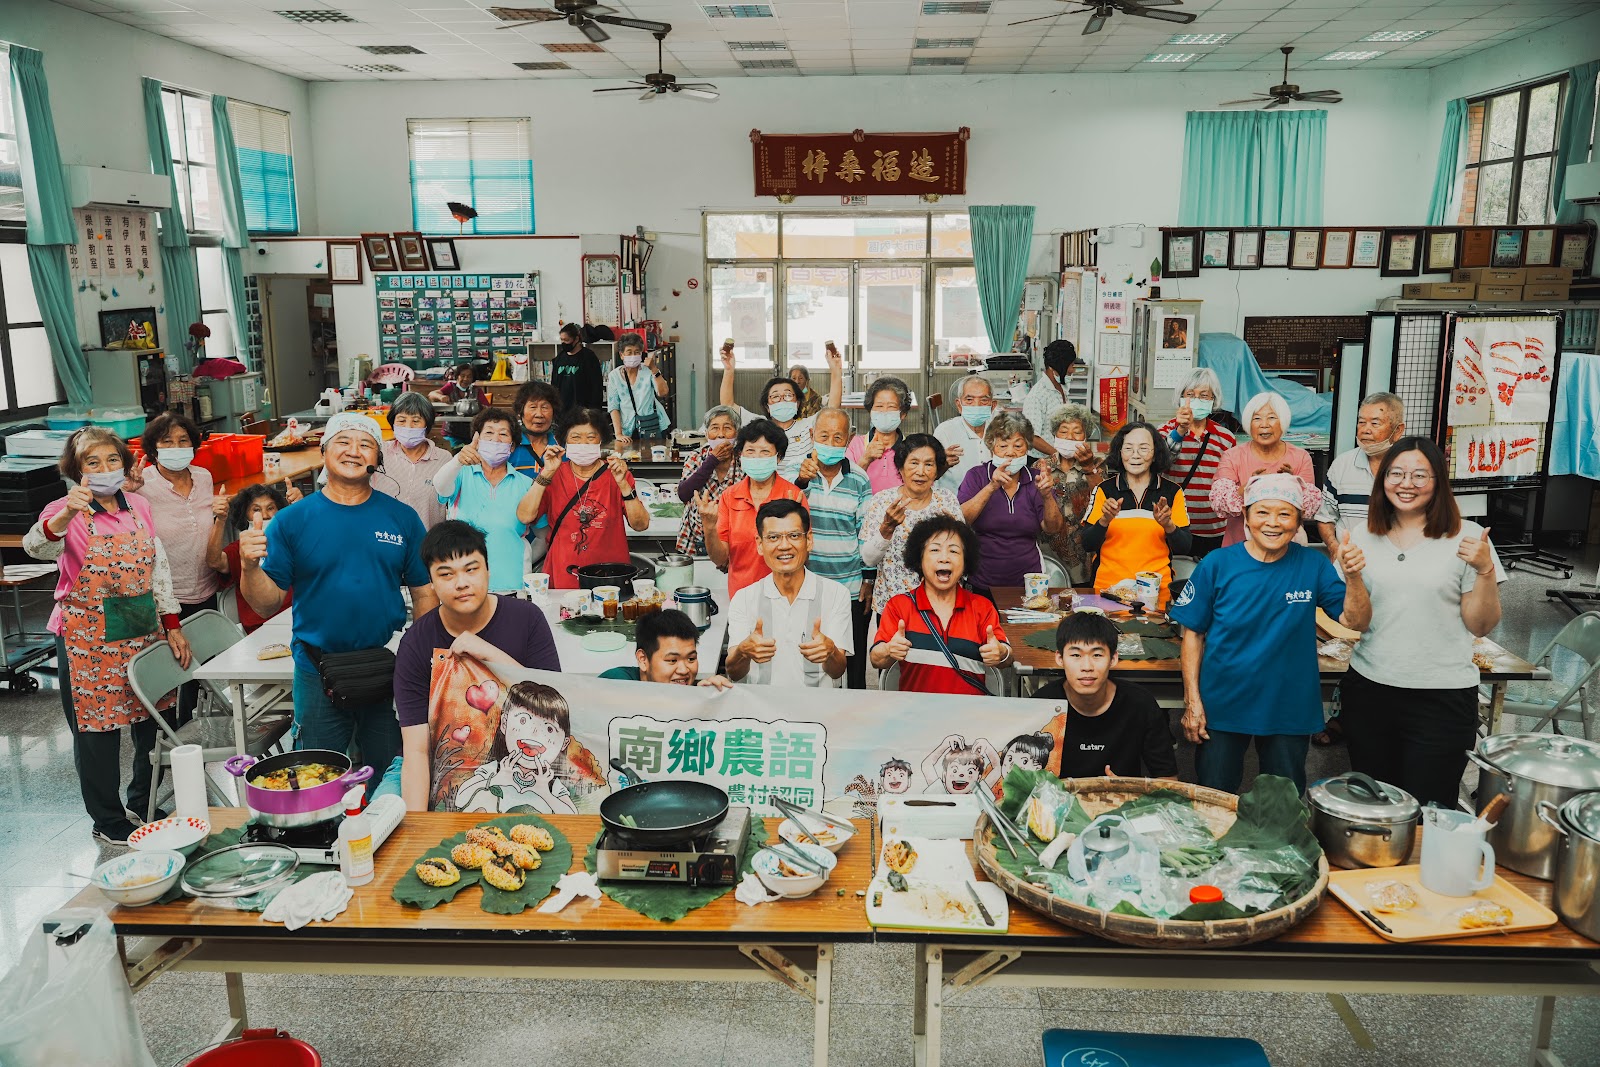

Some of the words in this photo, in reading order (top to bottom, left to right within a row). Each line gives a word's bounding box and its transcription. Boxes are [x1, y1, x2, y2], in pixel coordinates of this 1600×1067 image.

[618, 726, 817, 780] 南鄉農語
[728, 783, 814, 808] 農村認同
